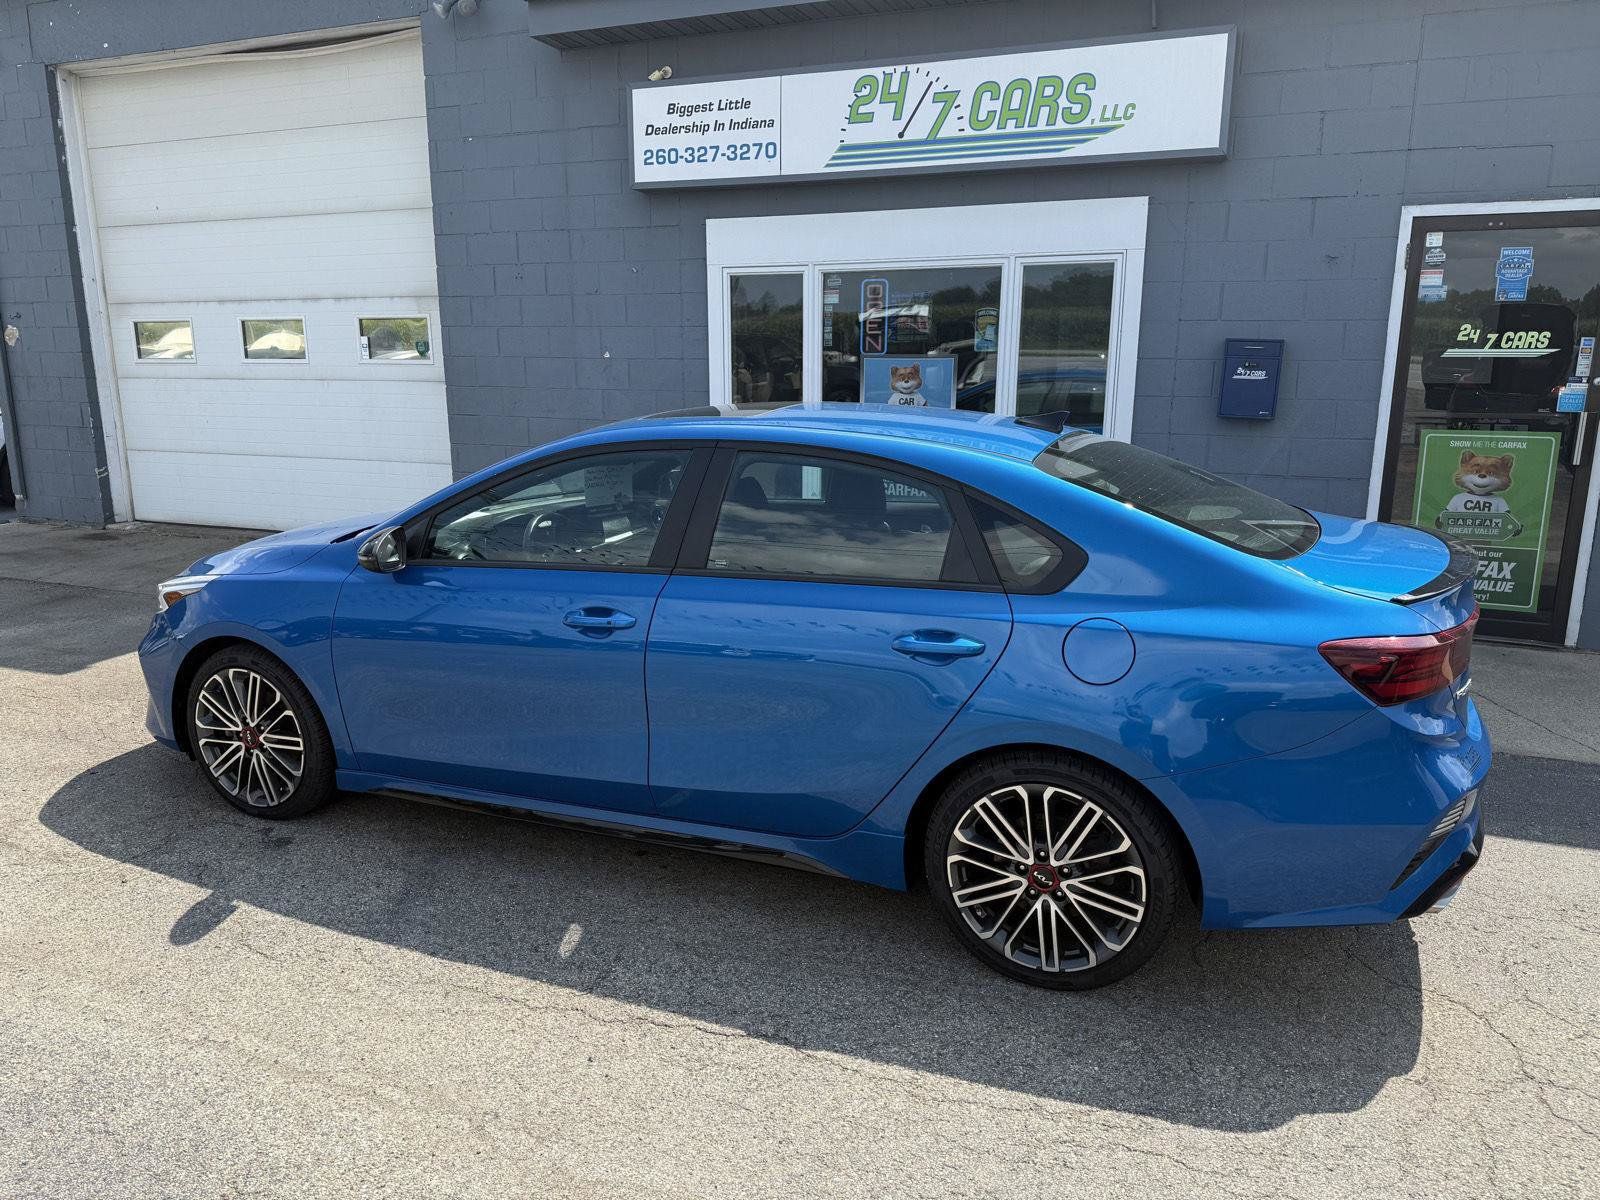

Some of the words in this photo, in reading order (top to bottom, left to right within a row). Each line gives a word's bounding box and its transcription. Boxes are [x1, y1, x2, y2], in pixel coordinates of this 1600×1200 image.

[667, 102, 714, 117] Biggest
[717, 97, 751, 111] Little
[1100, 103, 1137, 122] LLC
[645, 121, 710, 136] Dealership
[713, 120, 725, 132] In
[728, 117, 775, 131] Indiana
[643, 141, 777, 166] 260-327-3270
[1500, 331, 1552, 349] CARS
[898, 397, 915, 406] CAR
[1449, 440, 1472, 448] SHOW
[1498, 441, 1528, 449] CARFAX
[1463, 500, 1493, 512] CAR
[1447, 517, 1502, 528] CARFAX
[1447, 527, 1474, 535] GREAT
[1475, 560, 1517, 579] FAX
[1473, 580, 1515, 593] VALUE
